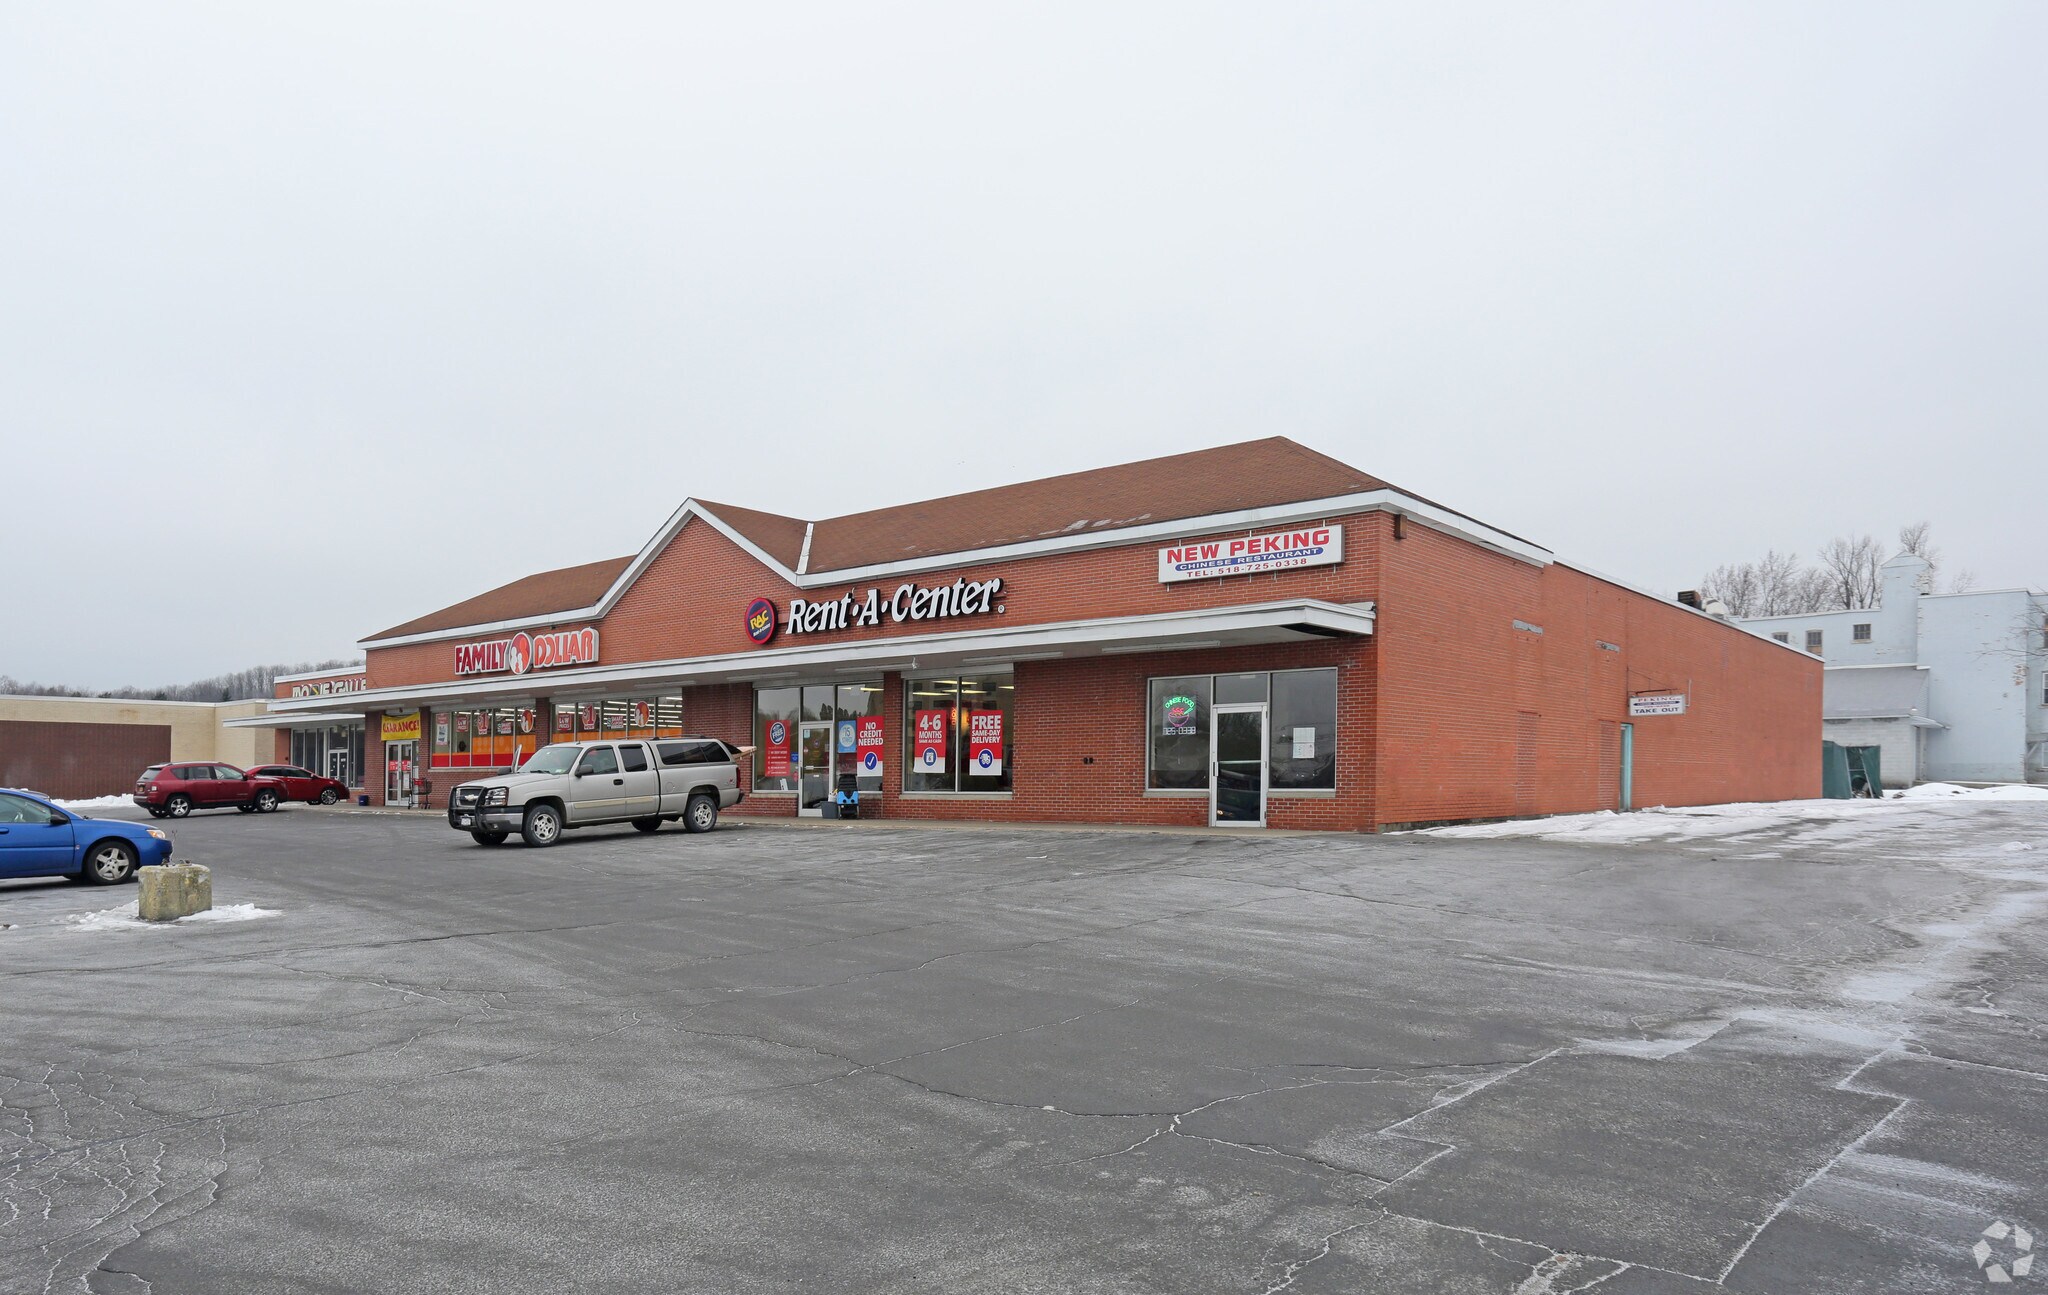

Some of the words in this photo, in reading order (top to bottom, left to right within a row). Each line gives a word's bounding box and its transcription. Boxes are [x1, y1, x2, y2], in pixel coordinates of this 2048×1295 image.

[1167, 543, 1220, 564] NEW
[1230, 529, 1330, 556] PEKING
[1179, 558, 1232, 571] CHINESE
[1237, 548, 1319, 564] RESTAURANT
[1187, 570, 1214, 578] TEL:
[1218, 558, 1307, 575] 518-725-0338
[455, 640, 508, 673] FAMILY
[534, 630, 594, 667] DOLLAR
[865, 721, 877, 730] NO
[920, 714, 942, 730] 4-6
[972, 715, 1002, 730] FREE
[859, 729, 882, 738] CREDIT
[918, 730, 943, 739] MONTHS
[971, 729, 1001, 737] SAME-DAY
[858, 738, 884, 746] NEEDED
[971, 736, 1001, 744] DELIVERY
